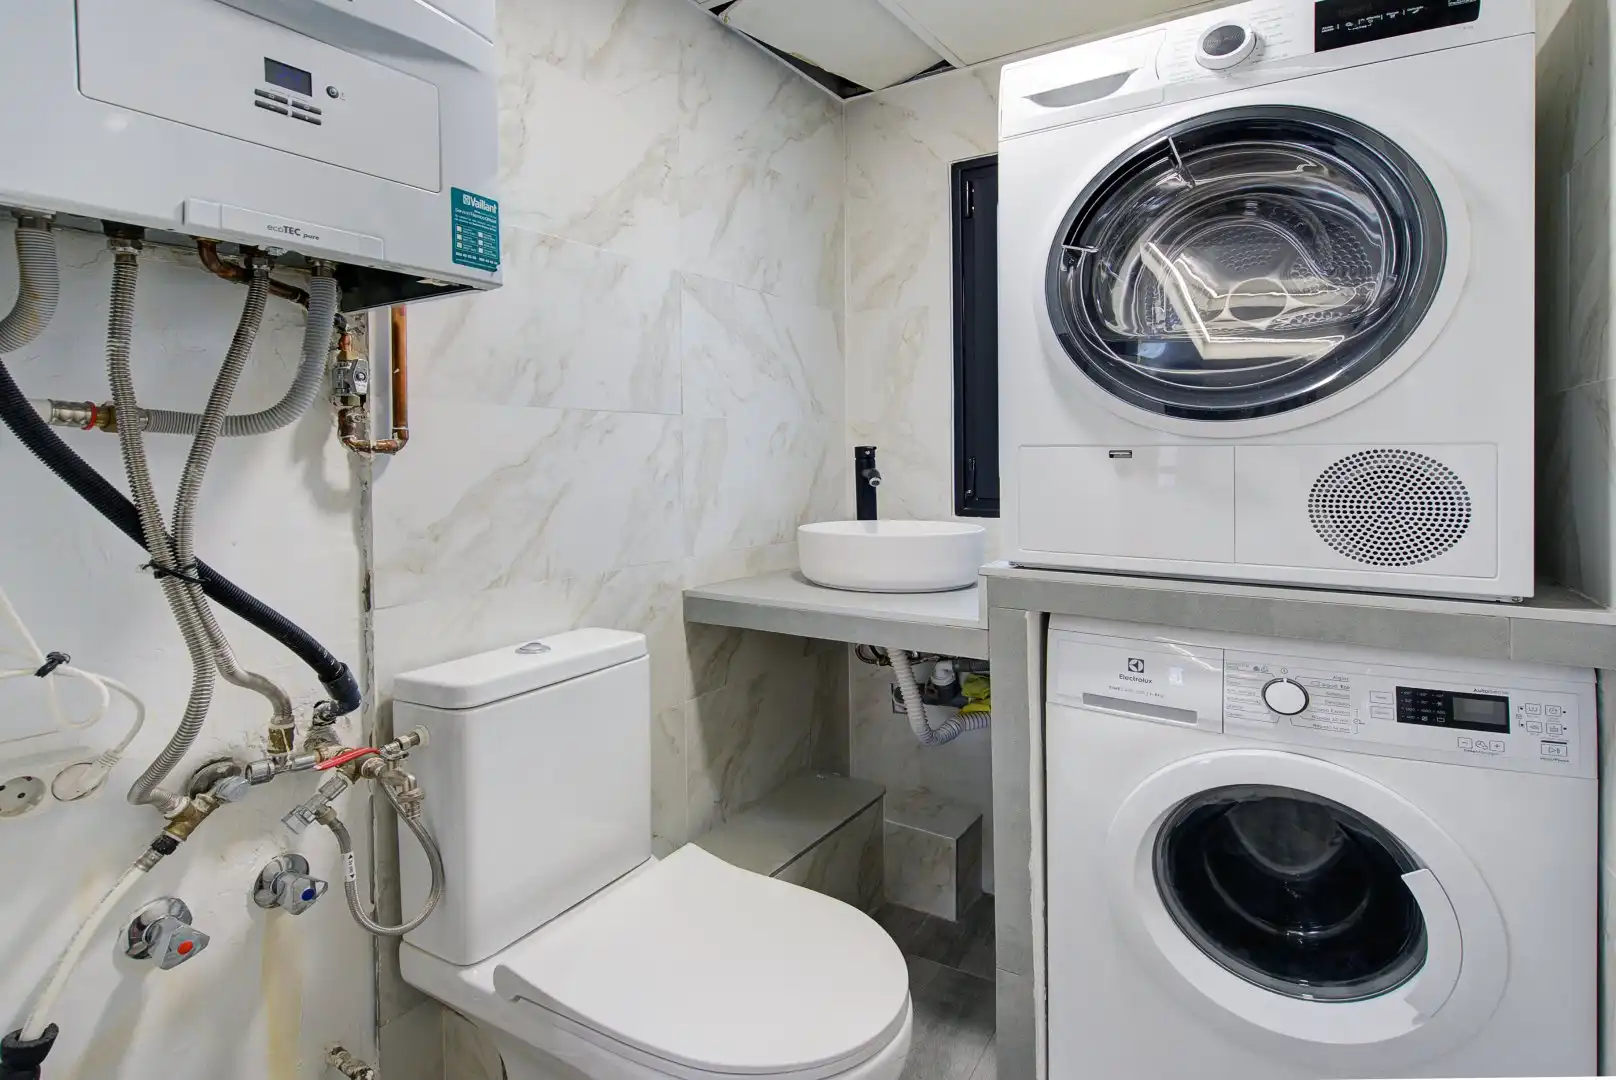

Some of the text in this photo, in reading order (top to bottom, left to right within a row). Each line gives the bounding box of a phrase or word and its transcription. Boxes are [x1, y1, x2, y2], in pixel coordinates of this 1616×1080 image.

[470, 196, 497, 213] Vaillant
[266, 224, 320, 241] ecoTEC pure
[1118, 673, 1153, 684] Electrolux
